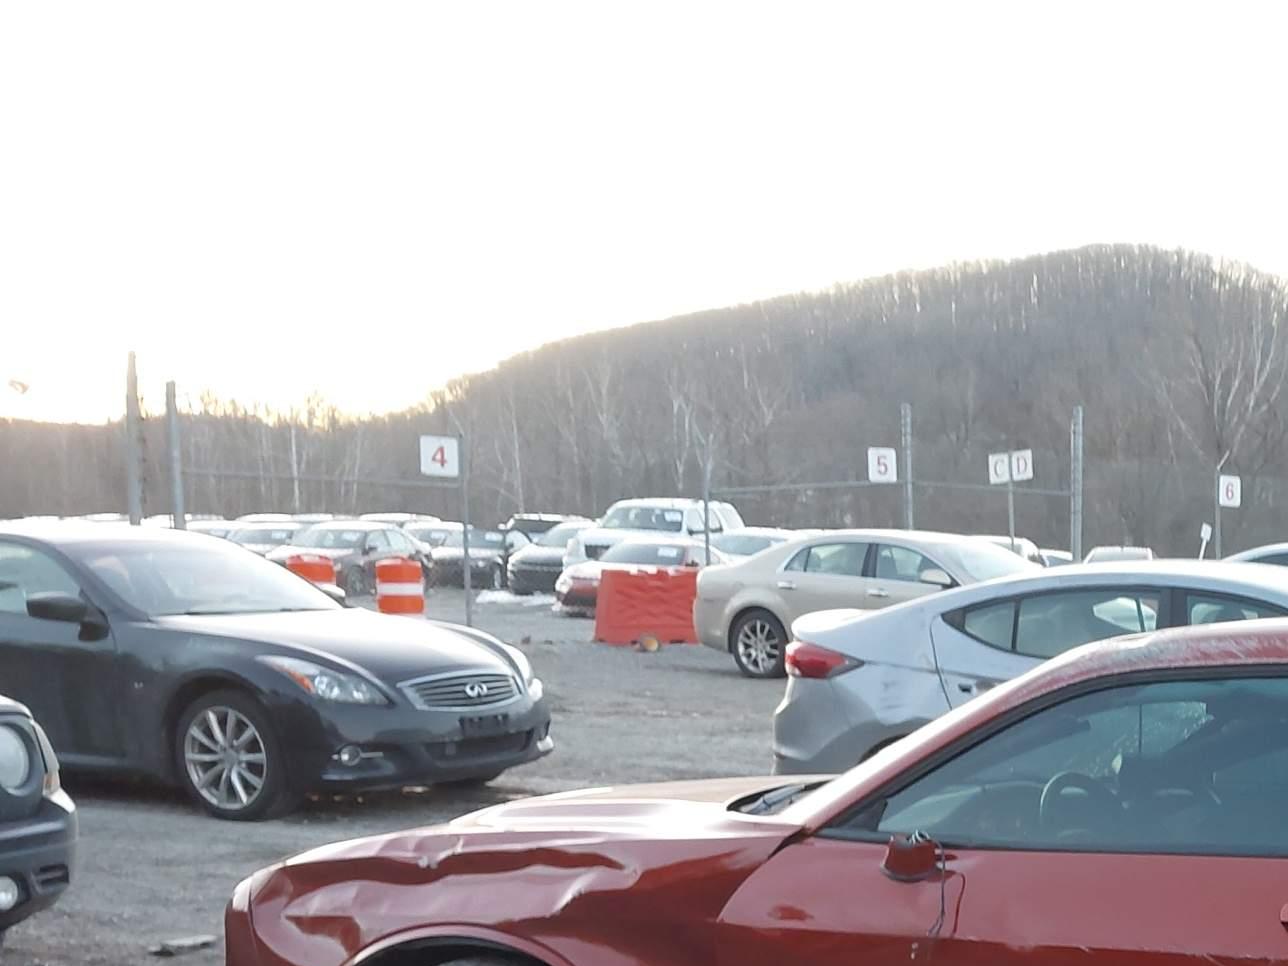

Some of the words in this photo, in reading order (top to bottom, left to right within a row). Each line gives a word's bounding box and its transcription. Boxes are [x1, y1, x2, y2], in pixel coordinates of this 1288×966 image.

[431, 446, 448, 468] 4
[876, 455, 889, 476] 5
[1016, 455, 1029, 475] D
[993, 458, 1005, 478] C
[1225, 482, 1235, 501] 6
